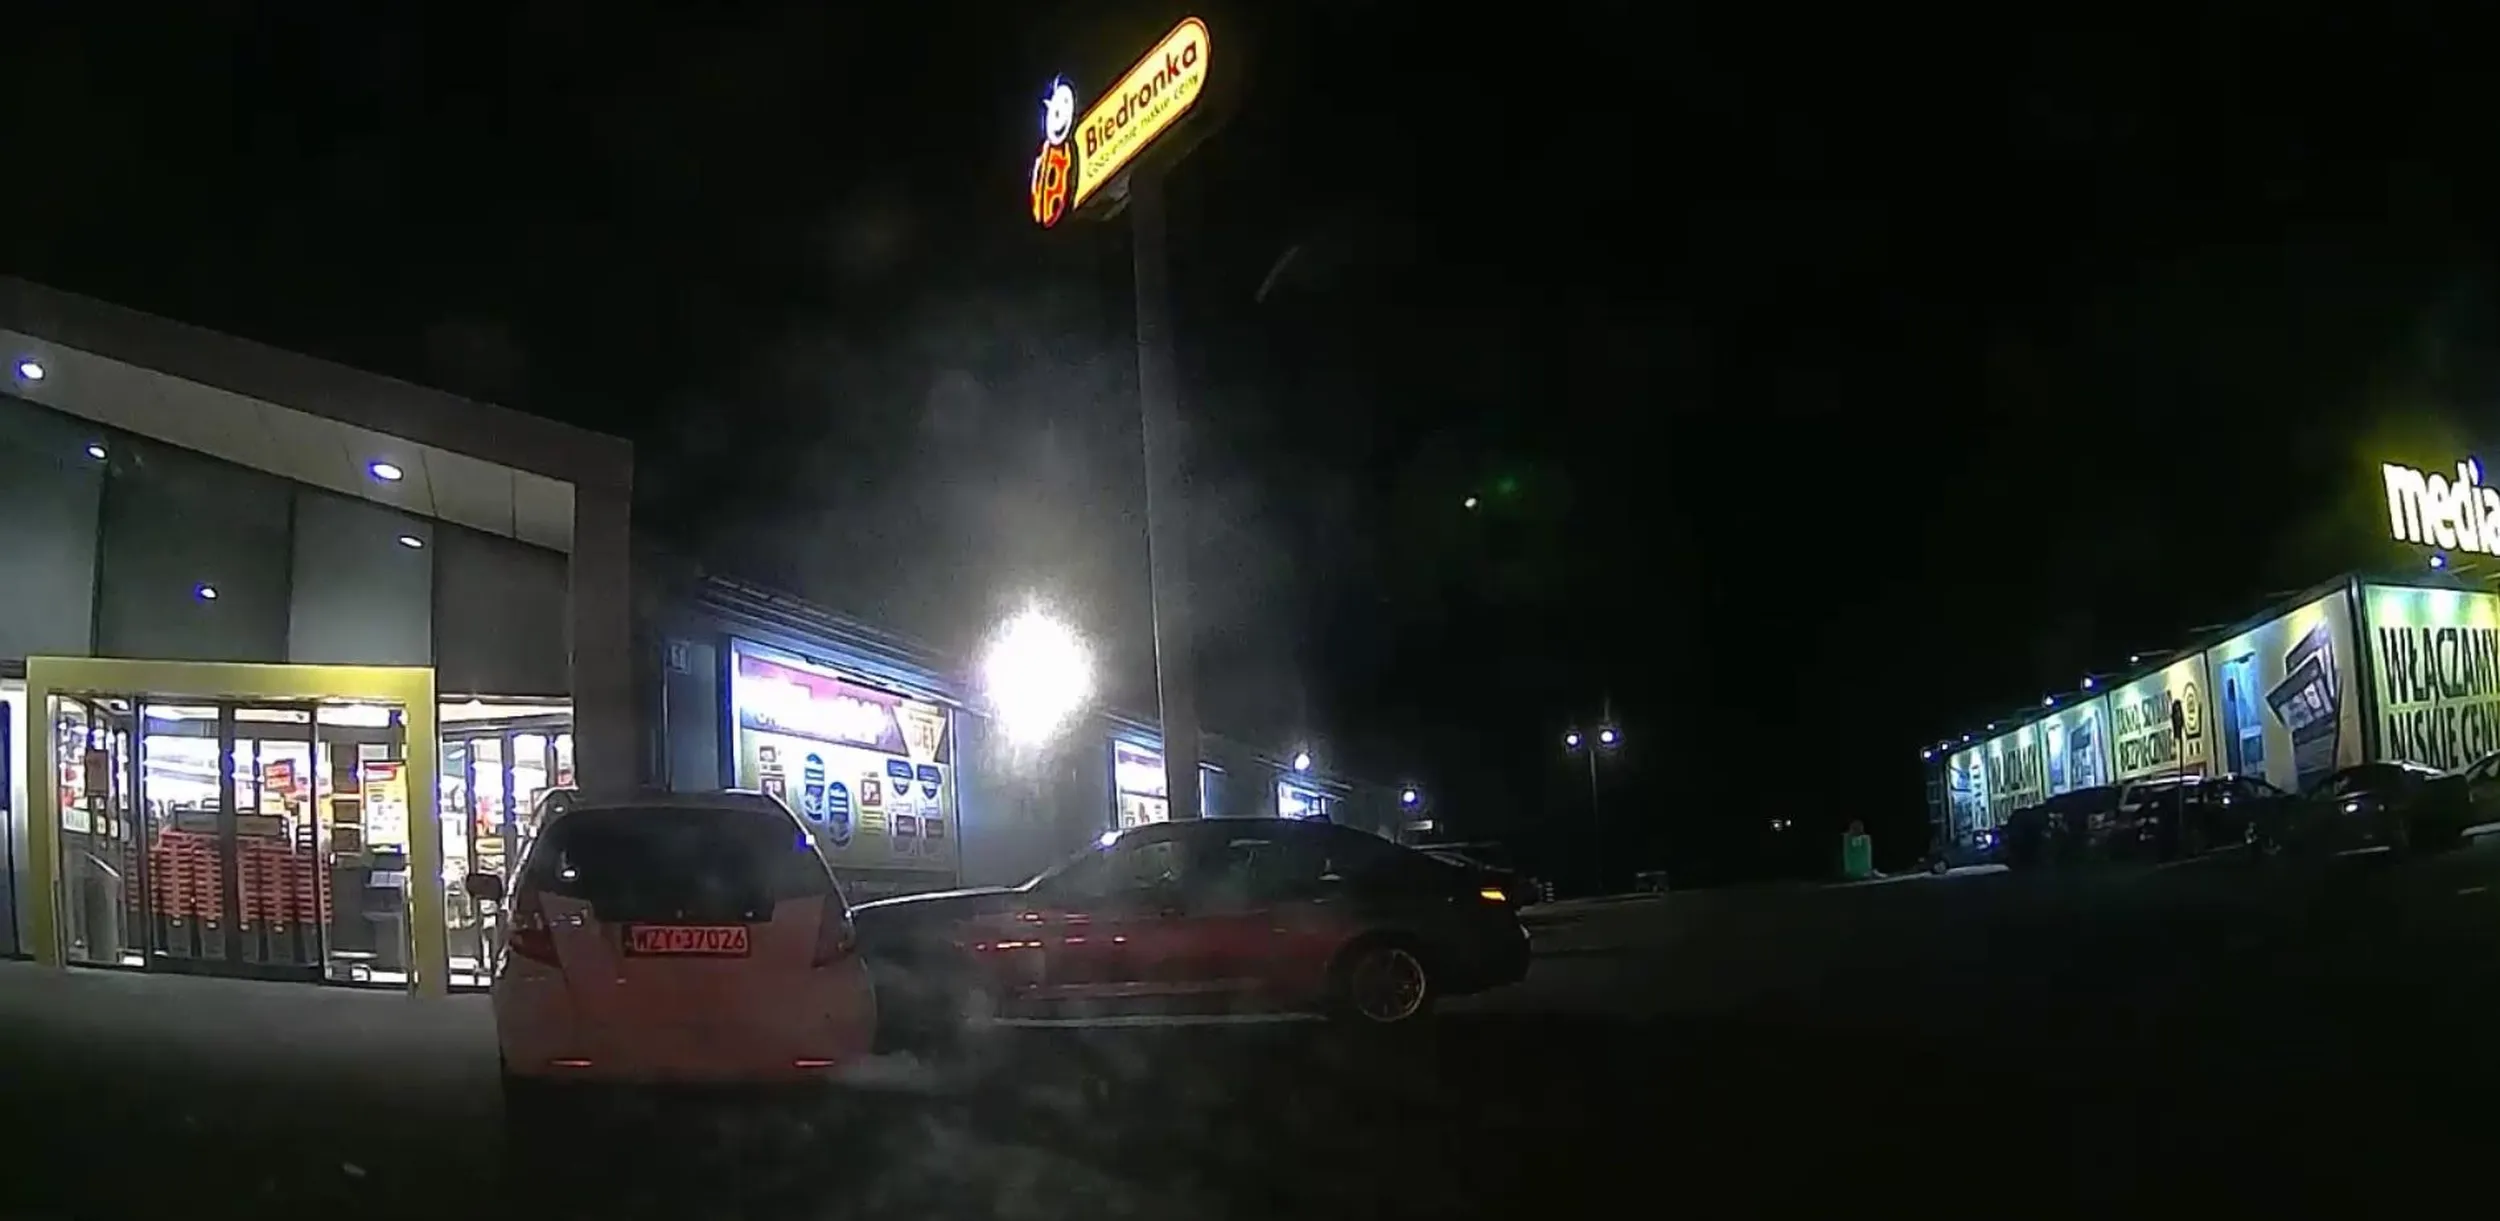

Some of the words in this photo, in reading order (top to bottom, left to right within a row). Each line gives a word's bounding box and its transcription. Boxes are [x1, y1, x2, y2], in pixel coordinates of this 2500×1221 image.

[1085, 40, 1198, 159] Biedronka
[2381, 456, 2500, 556] media
[636, 928, 674, 950] WZY
[682, 928, 746, 950] 37026
